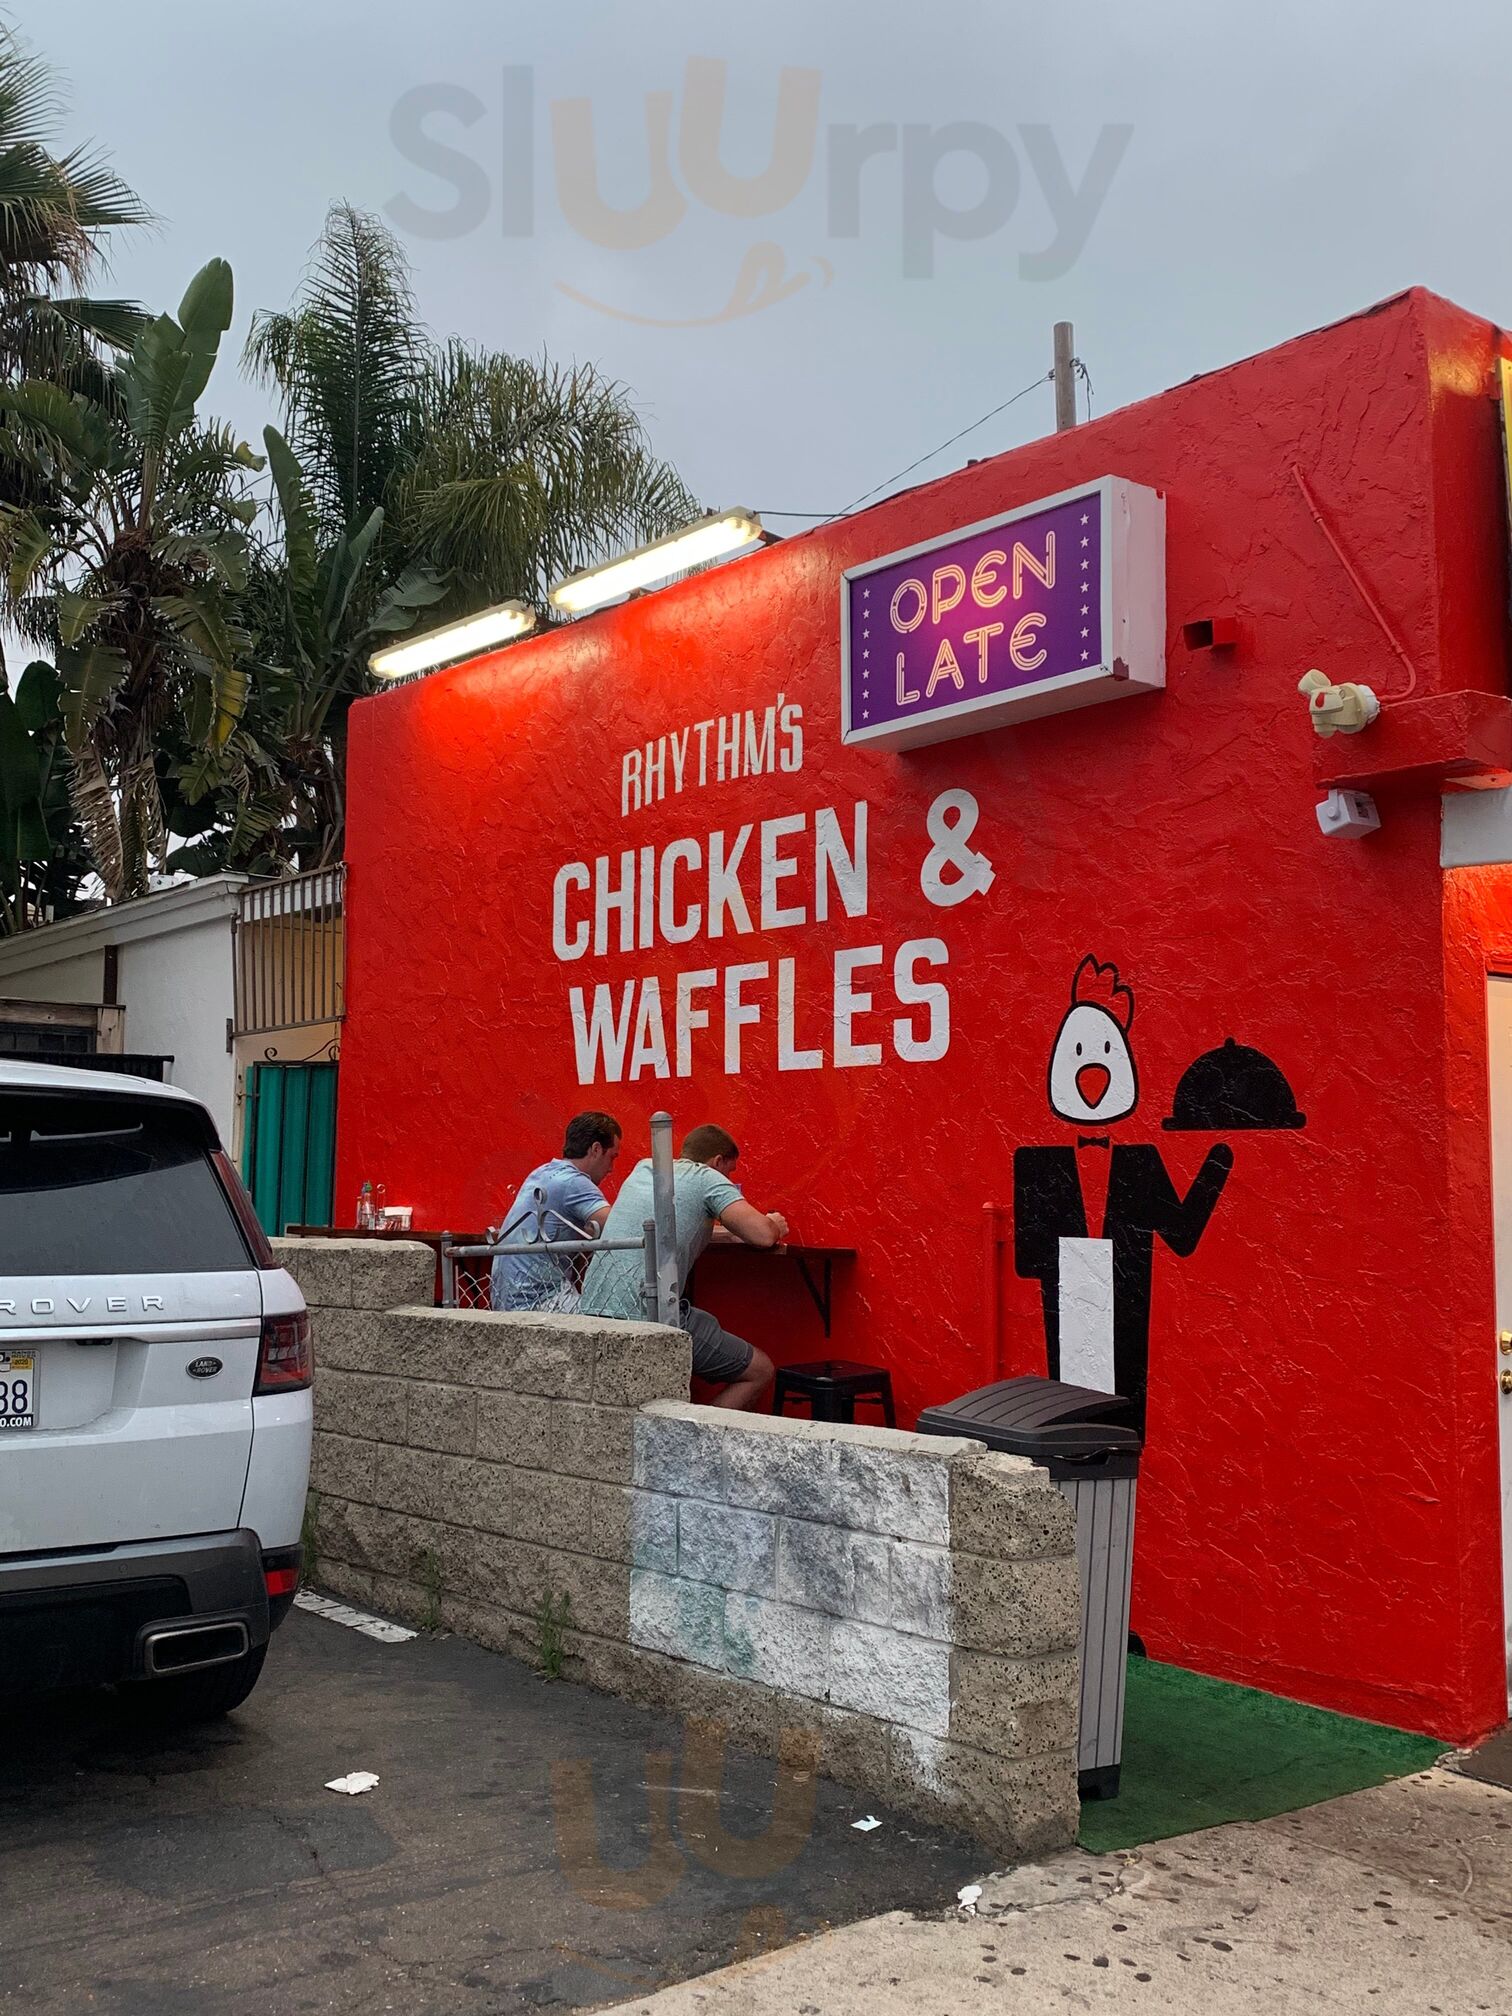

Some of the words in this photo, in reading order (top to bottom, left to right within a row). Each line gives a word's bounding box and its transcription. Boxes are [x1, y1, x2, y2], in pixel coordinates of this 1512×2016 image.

[890, 531, 1055, 634] OPEN
[896, 612, 1047, 706] LATE
[621, 693, 803, 817] RHYTHM'S
[552, 800, 868, 962] CHICKEN
[920, 788, 997, 907] &
[569, 937, 951, 1086] WAFFLES
[0, 1295, 164, 1315] ROVER
